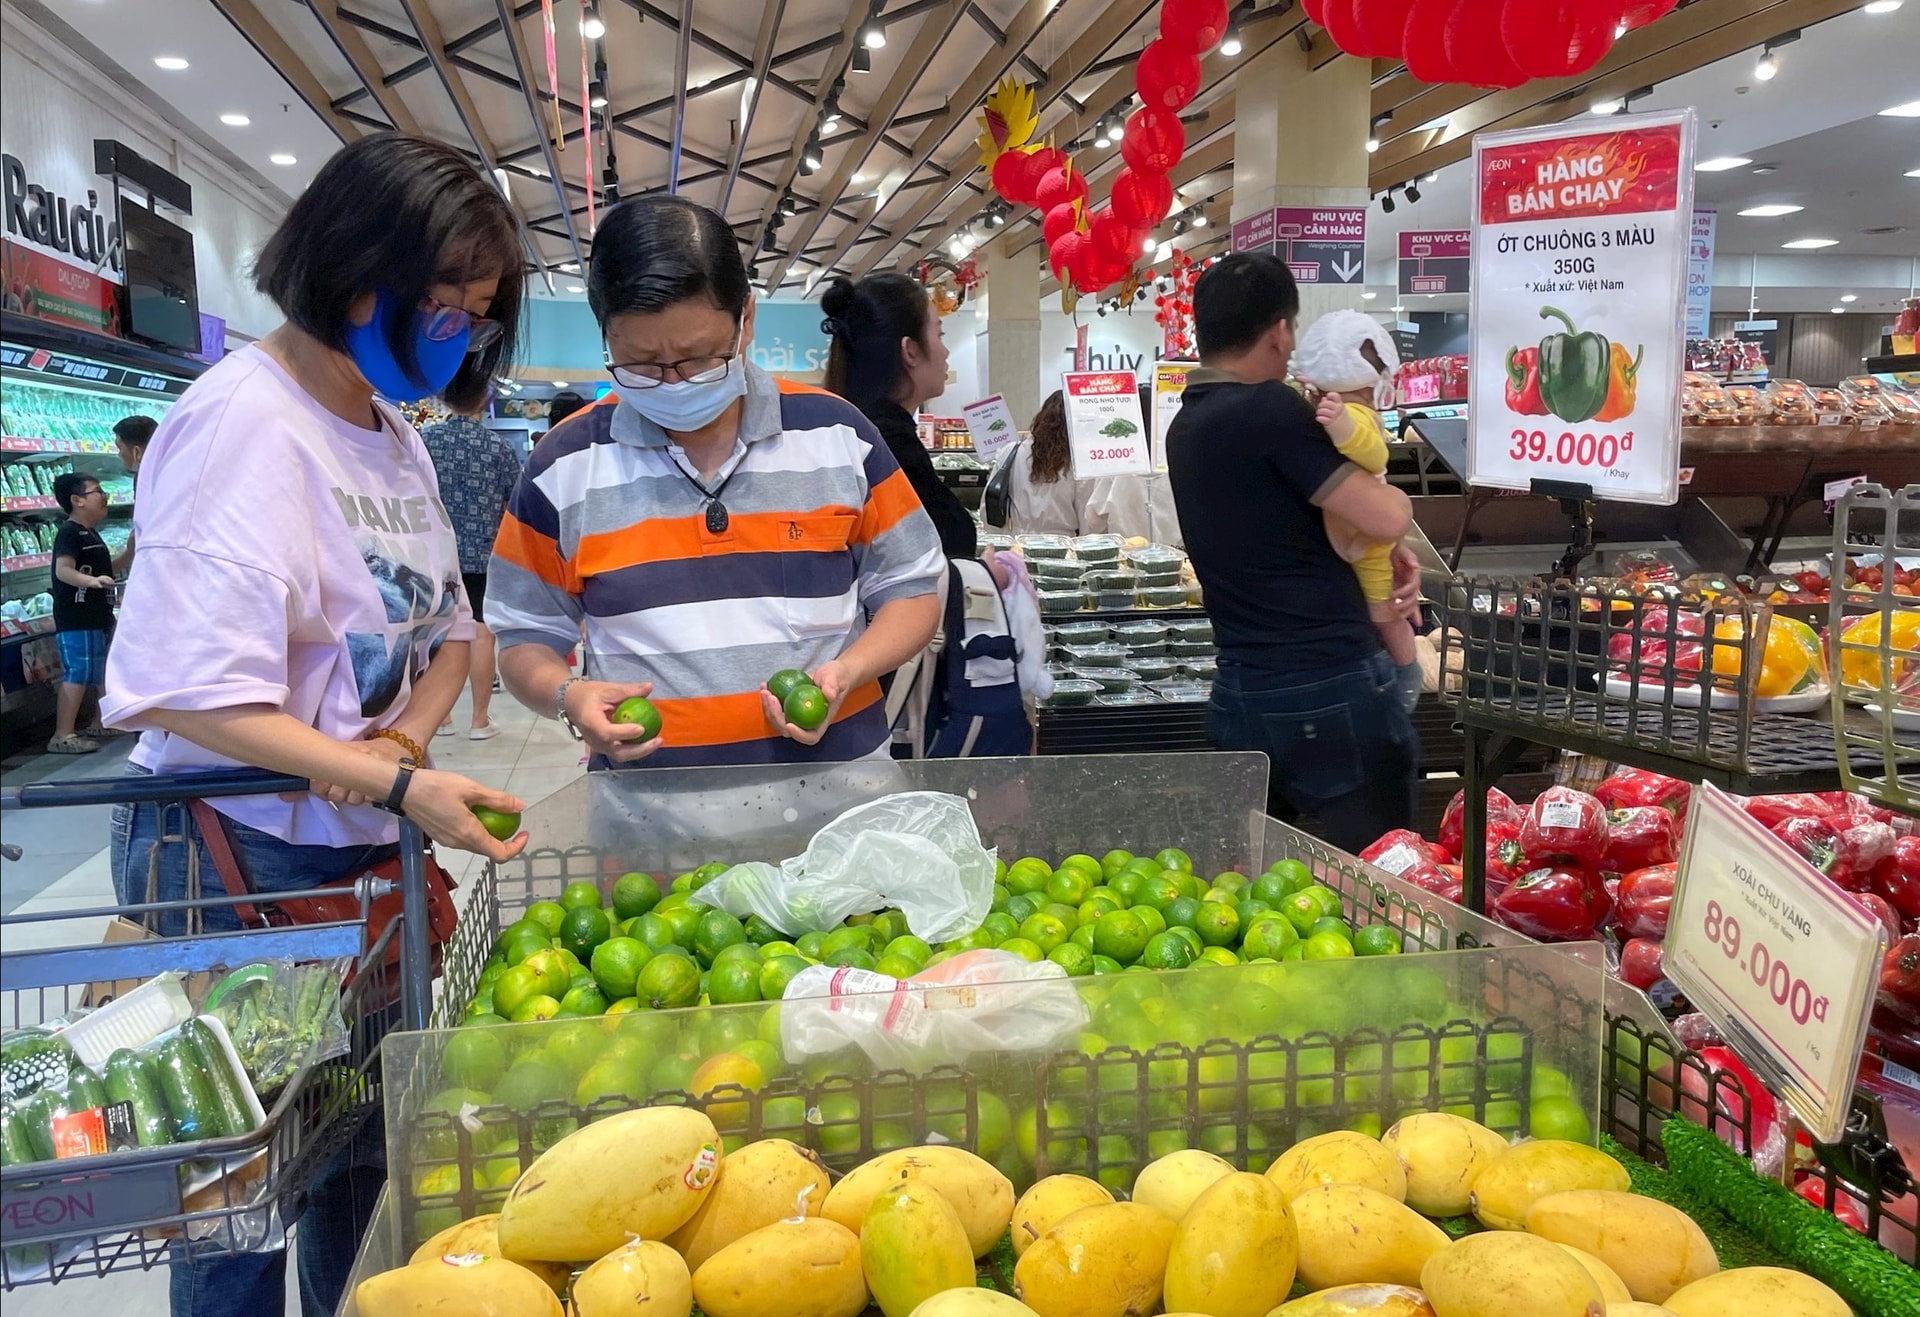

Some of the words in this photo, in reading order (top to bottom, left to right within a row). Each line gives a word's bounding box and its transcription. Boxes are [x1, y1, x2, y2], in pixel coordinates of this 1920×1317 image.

[1538, 155, 1604, 185] HÀNG
[1508, 187, 1555, 215] BÁN
[1560, 178, 1625, 208] CHẠY
[1303, 223, 1327, 235] CÂN
[1330, 223, 1362, 235] HÀNG
[1312, 212, 1336, 222] KHU
[1338, 211, 1363, 224] VỰC
[1412, 235, 1432, 243] KHU
[1434, 233, 1454, 245] VỰC
[1498, 232, 1519, 253] ỚT
[1523, 229, 1596, 251] CHUÔNG
[1601, 231, 1611, 247] 3
[1616, 224, 1655, 246] MÀU
[1554, 257, 1595, 275] 350G
[1578, 279, 1598, 293] Việt
[1600, 279, 1624, 291] Nam
[1509, 429, 1635, 467] 39.000đ
[1782, 901, 1812, 937] VÀNG
[1704, 899, 1829, 1026] 89.000đ
